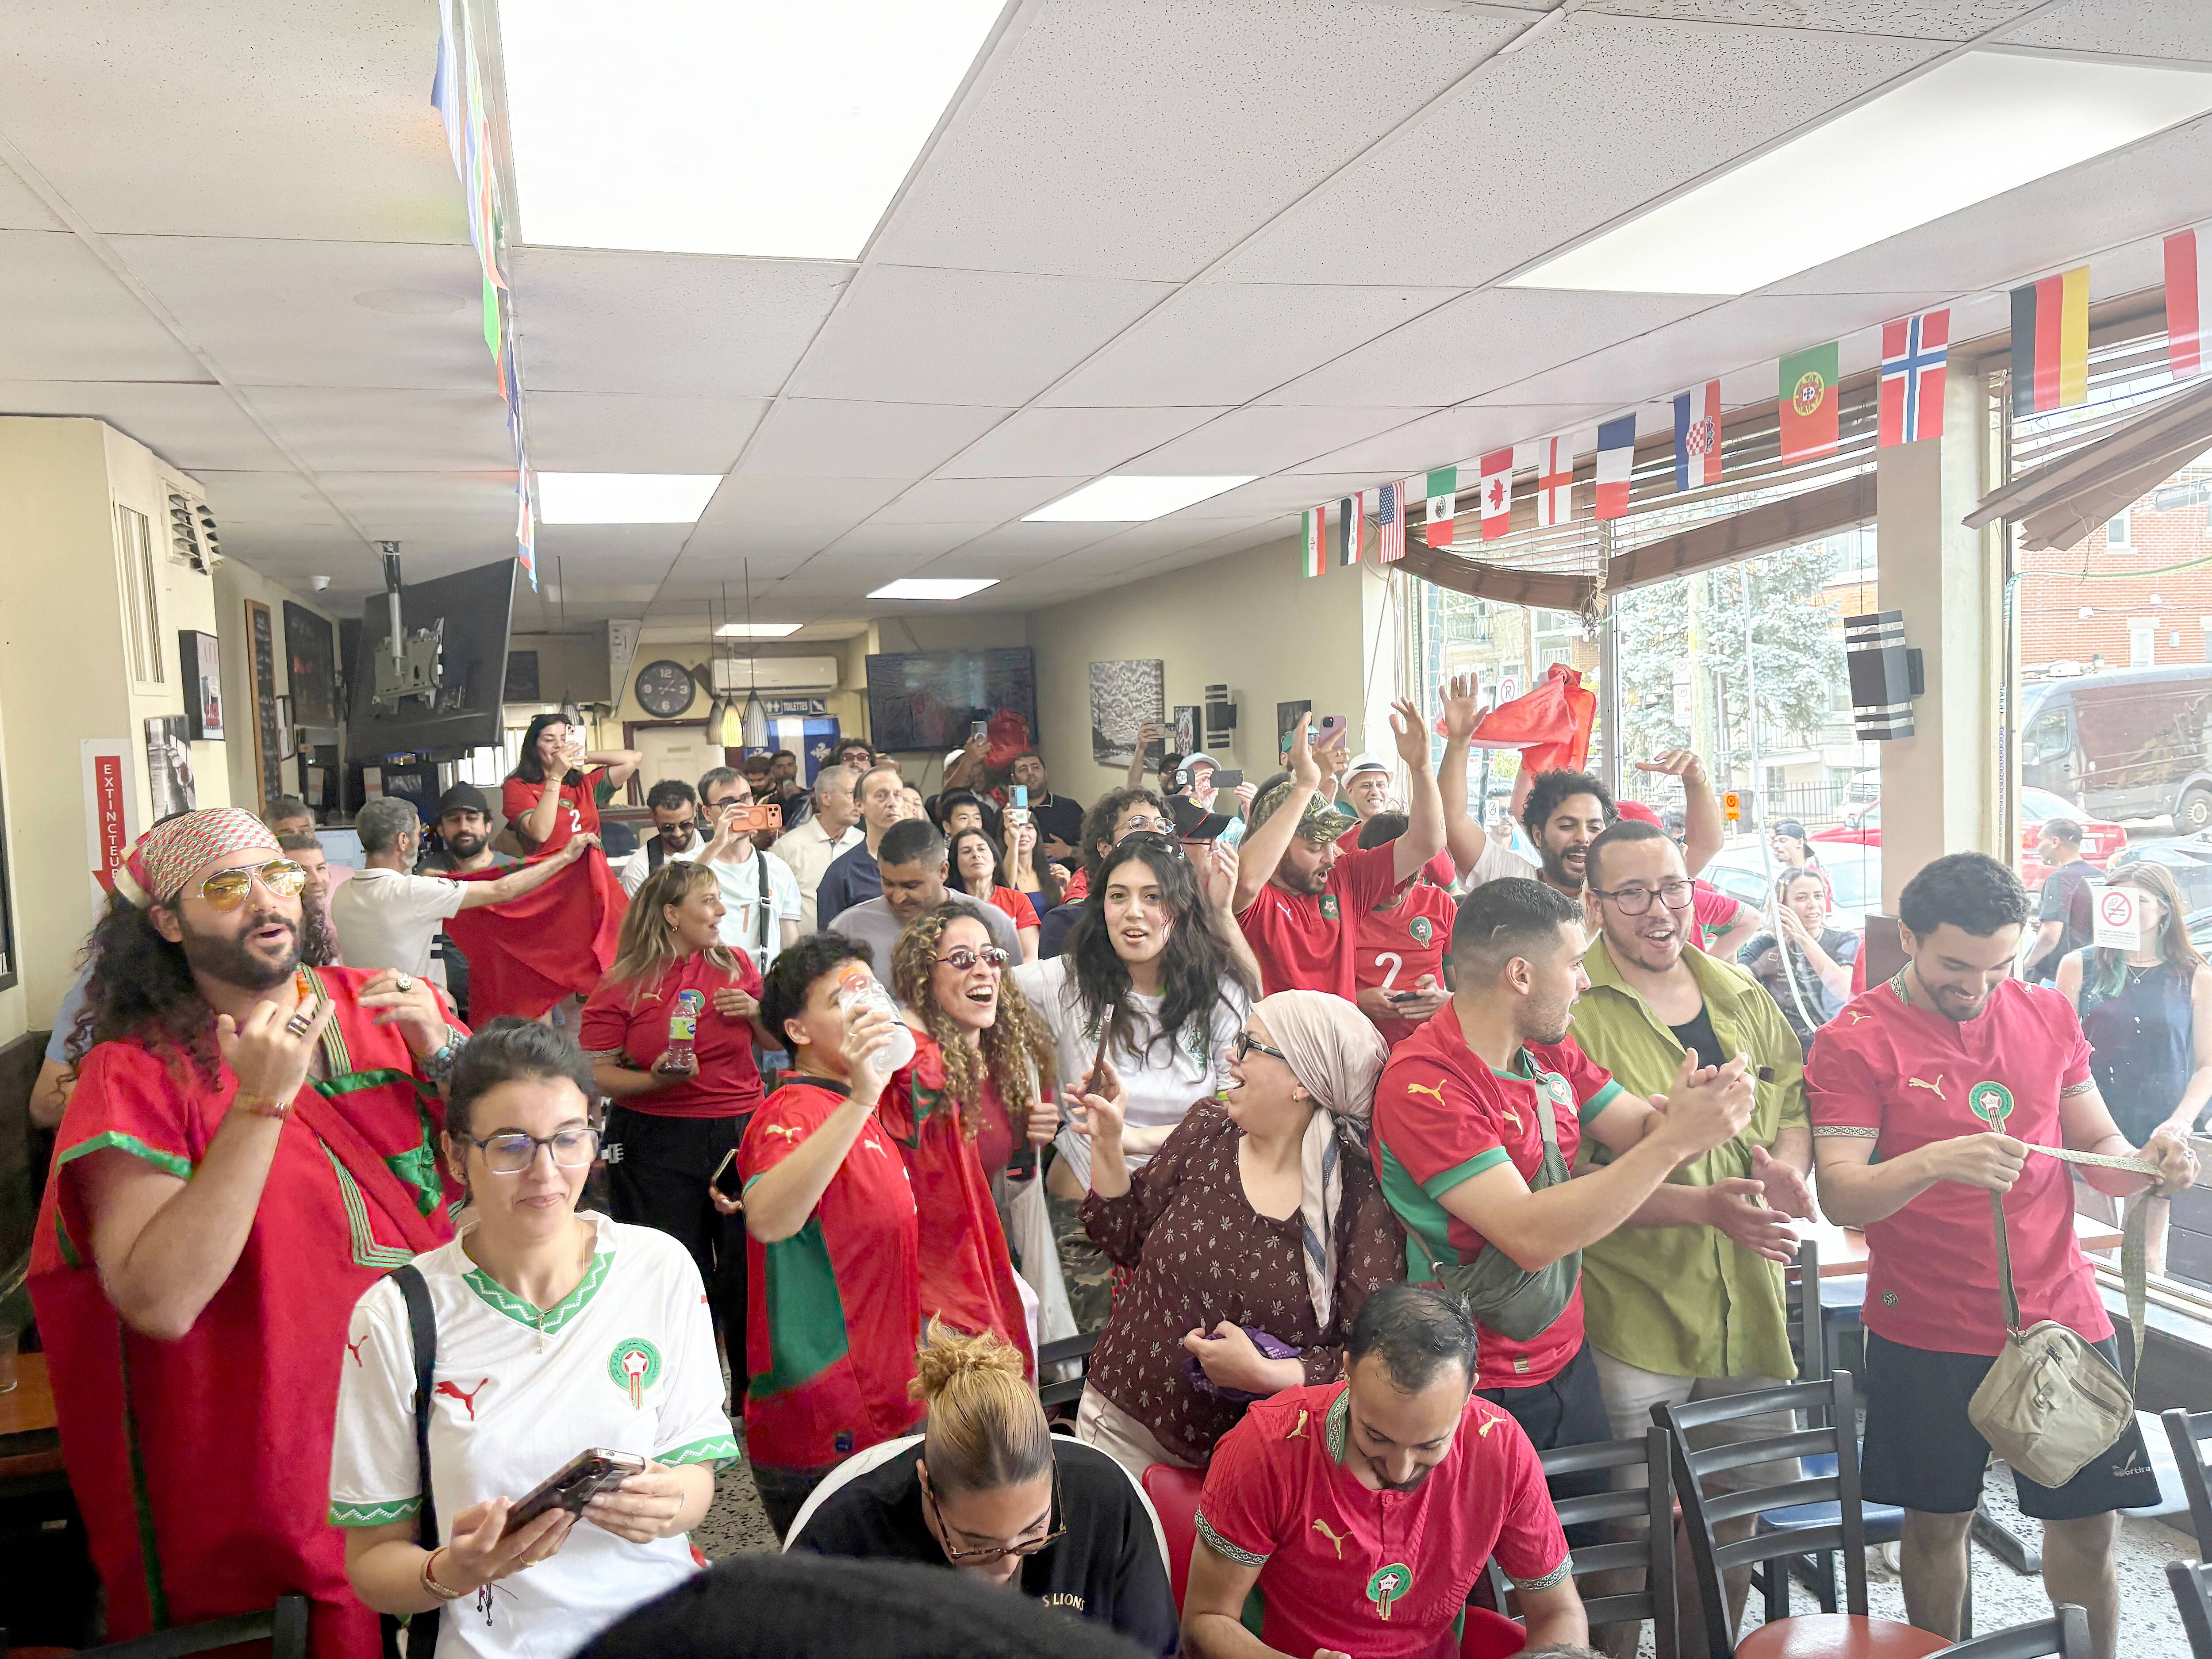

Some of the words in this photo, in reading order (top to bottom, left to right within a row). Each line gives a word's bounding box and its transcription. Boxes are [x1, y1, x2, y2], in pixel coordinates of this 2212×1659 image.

[660, 668, 672, 678] 12
[680, 685, 688, 695] 3
[662, 701, 670, 710] 6
[783, 701, 808, 711] TOILETTES
[569, 809, 582, 832] 2
[1375, 952, 1402, 989] 2
[1053, 1593, 1085, 1611] LIONS
